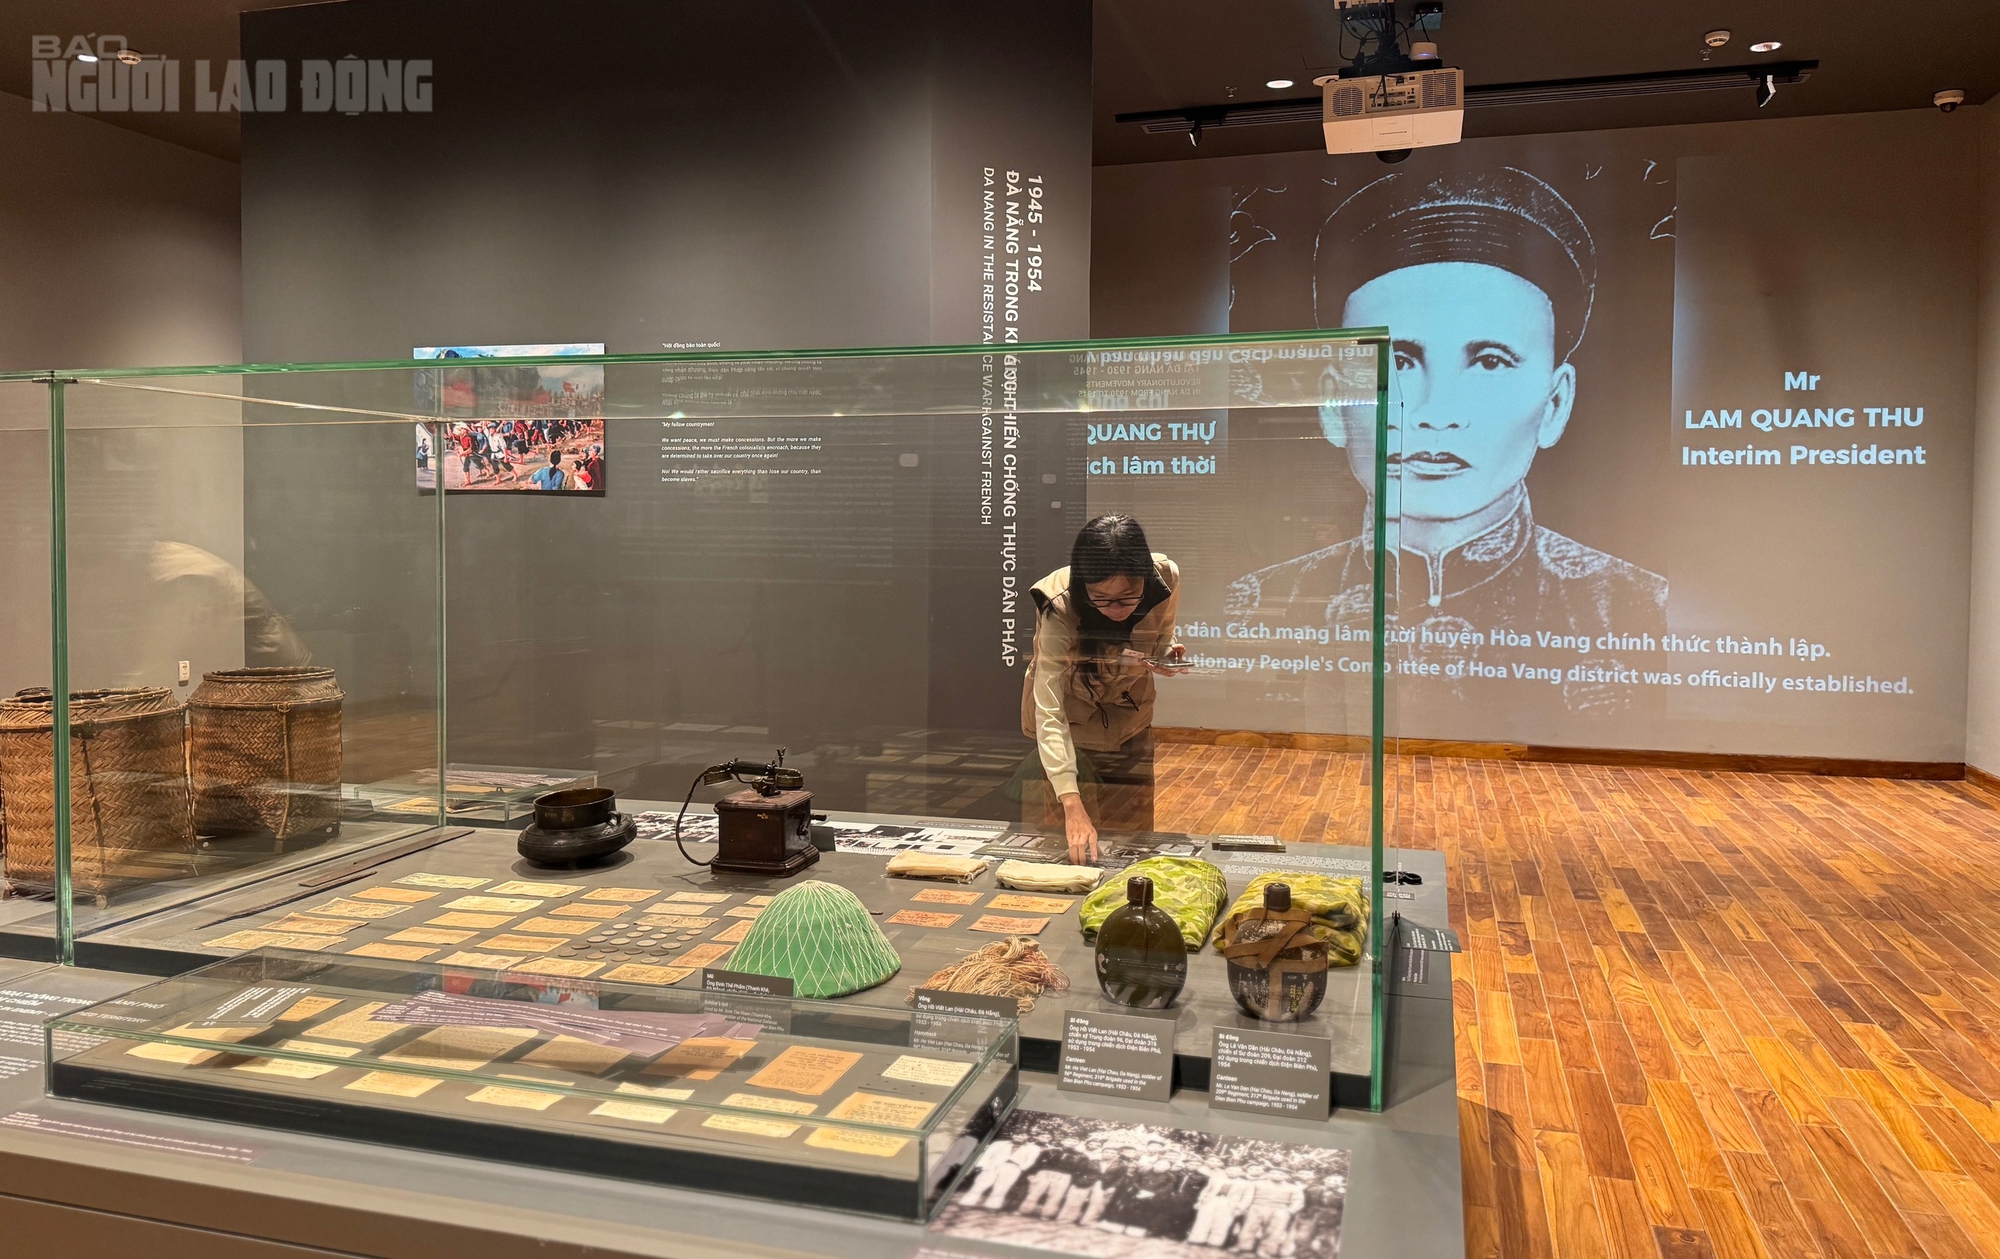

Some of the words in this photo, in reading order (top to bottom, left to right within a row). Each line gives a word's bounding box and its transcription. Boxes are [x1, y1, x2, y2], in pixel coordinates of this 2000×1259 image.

[983, 167, 995, 187] DA
[1006, 170, 1022, 196] ĐÀ
[983, 190, 995, 231] NANG
[1027, 175, 1043, 224] 1945
[983, 235, 994, 249] IN
[1005, 201, 1024, 254] NẴNG
[983, 253, 994, 281] THE
[1027, 244, 1043, 292] 1954
[1005, 259, 1019, 322] TRONG
[982, 284, 994, 372] RESISTACE
[982, 374, 993, 406] WAR
[1784, 371, 1821, 391] Mr
[1685, 409, 1743, 429] LAM
[1750, 407, 1855, 432] QUANG
[1863, 407, 1924, 427] THU
[1123, 455, 1164, 474] lâm
[1171, 455, 1216, 474] thời
[1682, 444, 1781, 465] Interim
[1790, 444, 1926, 465] President
[981, 471, 992, 525] FRENCH
[1003, 453, 1020, 517] CHỐNG
[1000, 522, 1017, 572] THỰC
[1002, 576, 1018, 613] DÂN
[1002, 618, 1018, 667] PHÁP
[1186, 622, 1221, 639] dân
[1226, 622, 1271, 640] Cách
[1275, 627, 1329, 645] mạng
[1335, 625, 1370, 642] lâm
[1421, 627, 1484, 649] huyện
[1490, 629, 1531, 647] Hòa
[1536, 630, 1590, 653] Vang
[1596, 632, 1656, 651] chính
[1661, 634, 1711, 653] thức
[1716, 636, 1782, 656] thành
[1789, 637, 1831, 662] lập.
[1260, 654, 1333, 674] People's
[1445, 660, 1464, 676] of
[1469, 661, 1508, 678] Hoa
[1511, 663, 1562, 684] Vang
[1567, 666, 1639, 684] district
[1643, 671, 1682, 686] was
[1687, 670, 1777, 693] officially
[1782, 675, 1914, 694] established.
[1065, 1056, 1086, 1064] Canteen
[1216, 1074, 1238, 1082] Canteen
